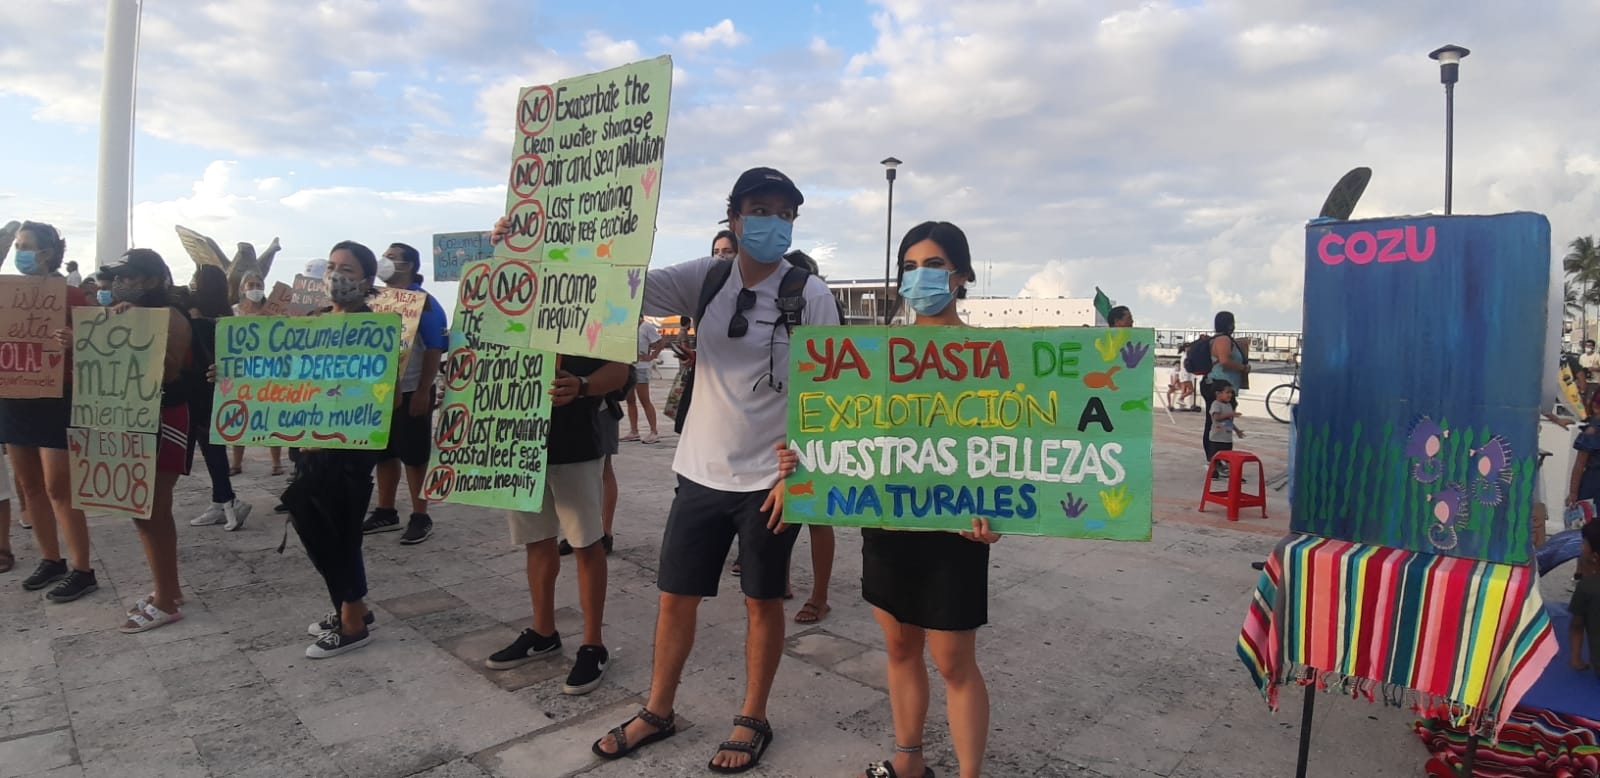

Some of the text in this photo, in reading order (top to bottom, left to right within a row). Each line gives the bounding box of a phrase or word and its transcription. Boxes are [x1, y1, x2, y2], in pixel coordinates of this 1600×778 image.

[522, 74, 650, 123] NO Exacerbate the
[560, 124, 597, 149] water
[602, 112, 653, 140] shorage
[516, 132, 664, 187] NO air and sea pollution
[579, 185, 632, 216] remaining
[512, 211, 539, 237] NO
[579, 218, 598, 242] reef
[600, 211, 638, 240] ecocide
[1318, 226, 1436, 265] COZU
[12, 287, 63, 312] isla
[497, 268, 597, 305] NO income
[76, 308, 155, 356] La
[270, 321, 396, 352] Cozumeleños
[538, 304, 588, 344] inequity
[220, 354, 387, 379] TENEMOS DERECHO
[450, 351, 543, 383] NO air and sea
[806, 337, 1082, 382] YA BASTA DE
[238, 381, 322, 403] a decidir
[800, 383, 1114, 432] EXPLOTACIÓN A
[224, 403, 382, 431] NO al cuarto muelle
[441, 410, 463, 444] NO
[496, 413, 550, 449] remaining
[79, 429, 151, 459] Y ES DEL
[440, 444, 490, 468] coastal
[490, 441, 519, 468] reef
[789, 436, 1126, 486] NUESTRAS BELLEZAS
[430, 470, 536, 497] NO income inequity
[826, 482, 1036, 519] NATURALES
